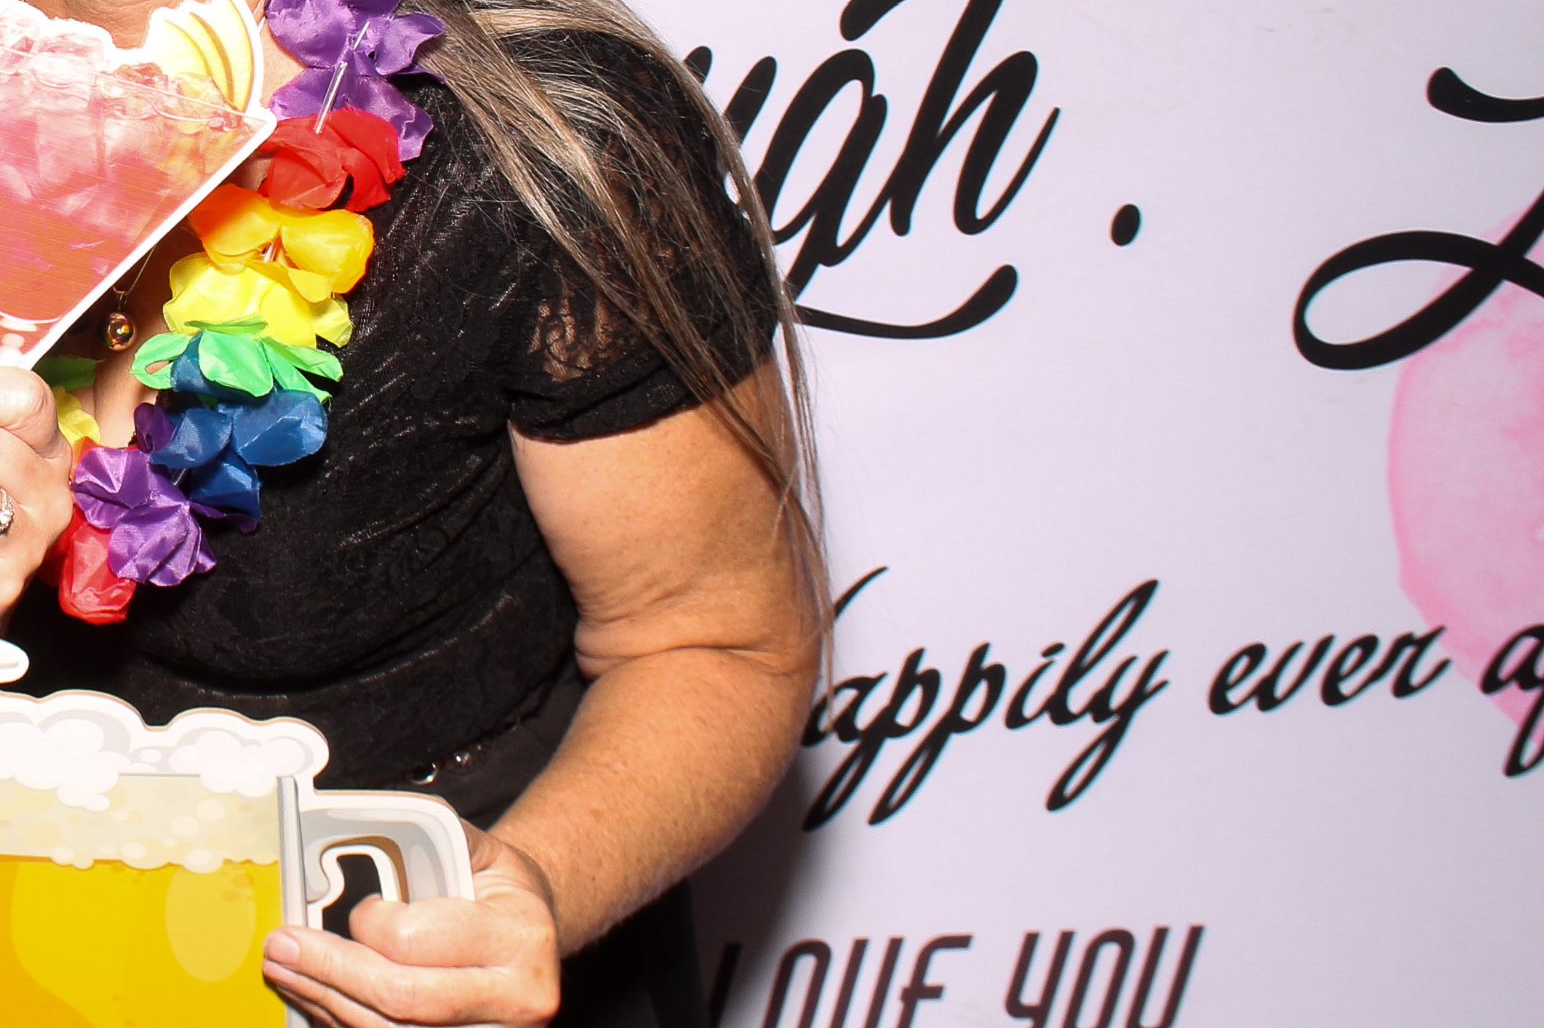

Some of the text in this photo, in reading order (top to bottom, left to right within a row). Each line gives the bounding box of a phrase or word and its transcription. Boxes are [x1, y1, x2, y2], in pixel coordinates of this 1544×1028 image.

[800, 565, 1170, 833] appily
[1208, 626, 1452, 715] ever
[1005, 925, 1204, 1028] YOU
